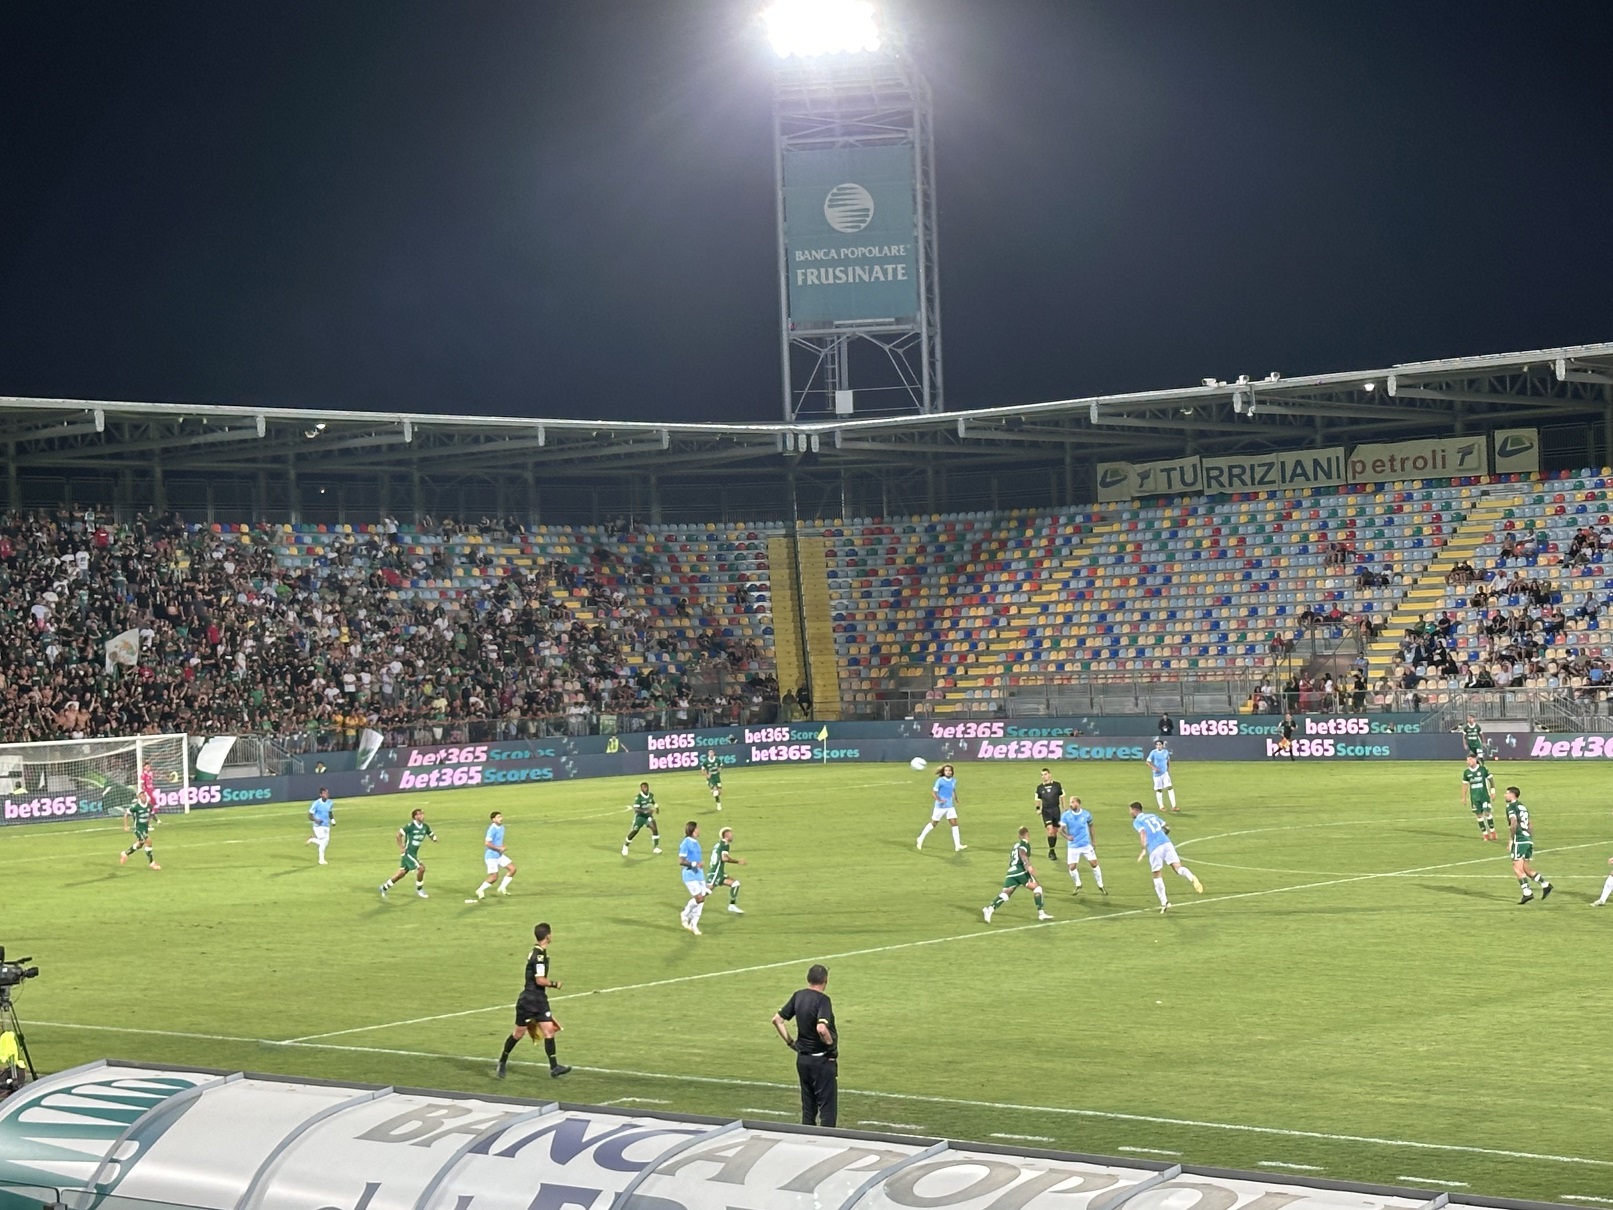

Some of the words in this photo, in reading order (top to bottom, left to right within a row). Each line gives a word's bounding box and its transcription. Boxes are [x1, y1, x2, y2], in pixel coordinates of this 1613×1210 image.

[796, 249, 838, 261] BANCA
[841, 245, 907, 259] POPOLARE
[796, 264, 908, 286] FRUSINATE
[1160, 456, 1341, 490] TURRIZIANI
[1350, 449, 1447, 480] petroli
[744, 727, 790, 743] bet365
[790, 729, 819, 740] Score
[931, 722, 1005, 738] bet365
[1179, 719, 1238, 735] bet365
[1305, 718, 1370, 735] bet365
[648, 733, 696, 750] bet365
[978, 740, 1064, 759] bet365
[1065, 743, 1144, 760] Scores
[1336, 742, 1391, 756] Scores
[648, 751, 699, 770] bet365
[752, 745, 812, 762] bet365
[399, 766, 483, 789] bet365
[483, 767, 553, 783] Scores
[222, 787, 272, 801] Scores
[4, 796, 78, 819] bet365
[1144, 817, 1162, 833] 13
